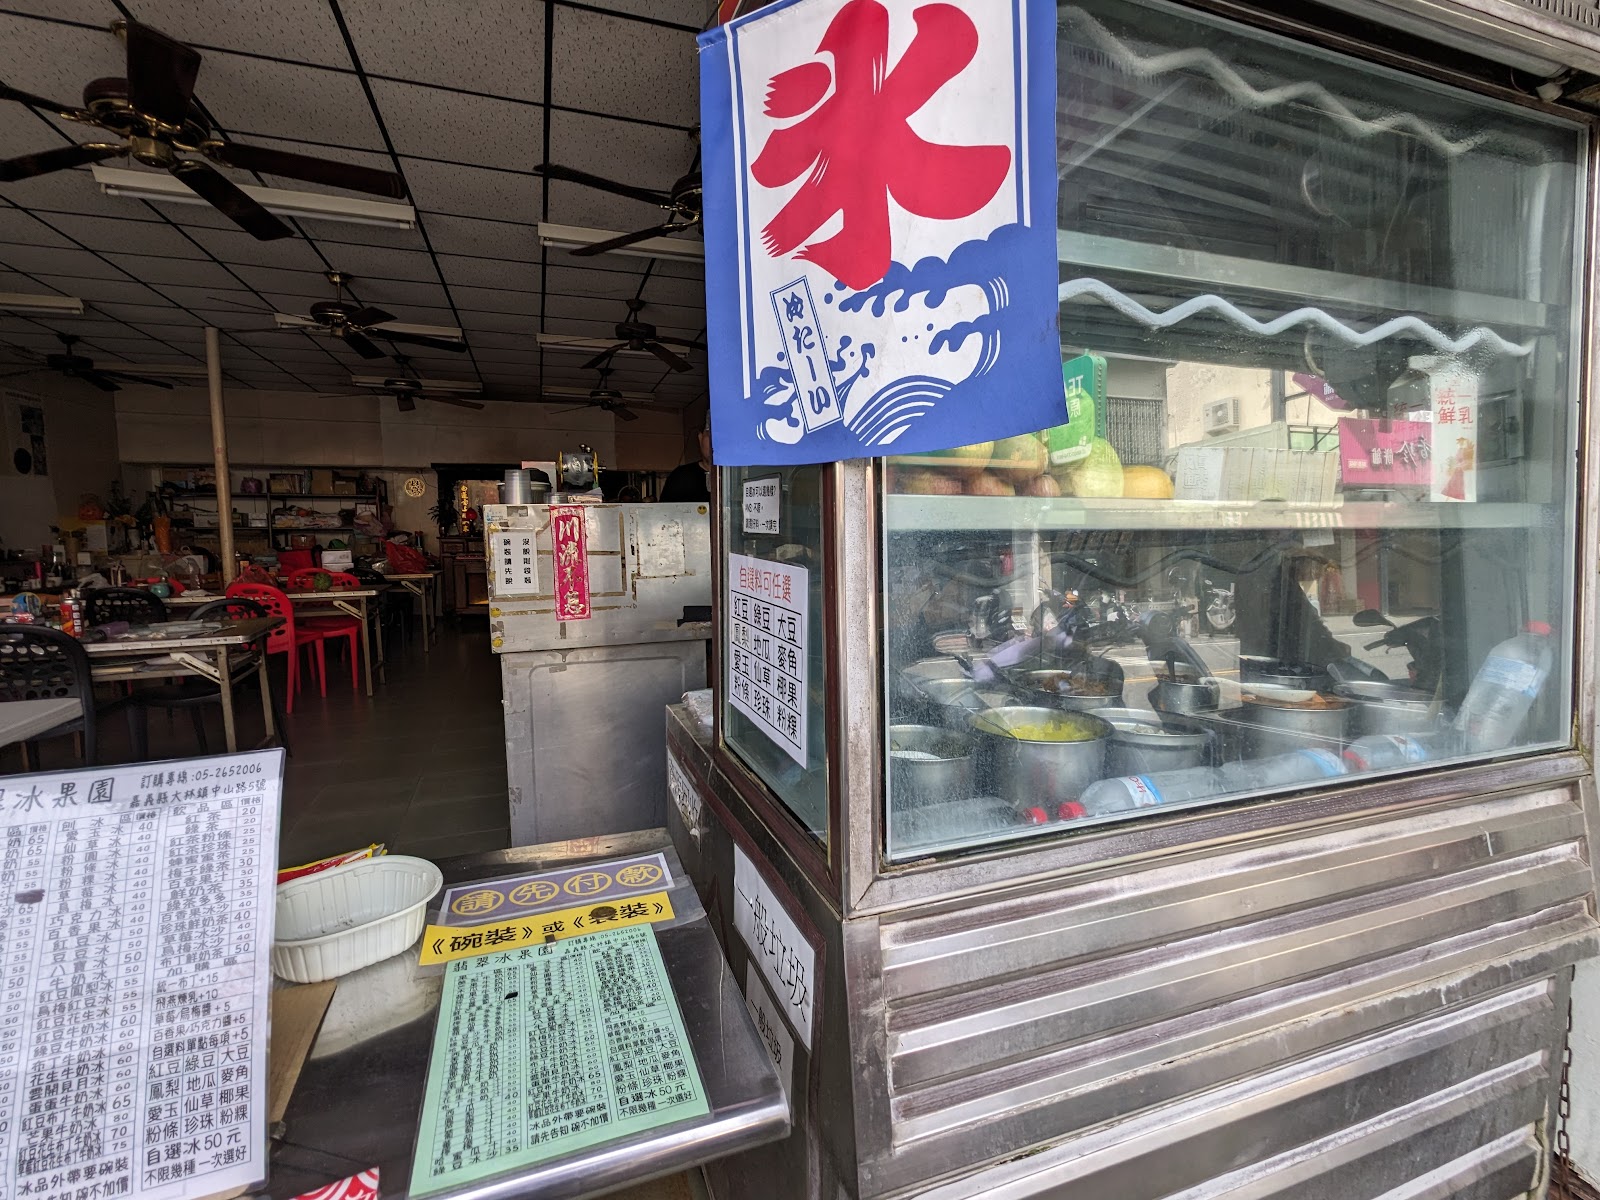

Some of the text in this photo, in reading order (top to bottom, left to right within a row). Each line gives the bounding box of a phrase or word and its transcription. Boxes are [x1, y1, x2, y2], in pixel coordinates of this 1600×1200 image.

[1437, 406, 1473, 425] 鮮乳
[740, 565, 791, 603] 自選料可任選
[734, 596, 748, 620] 紅豆
[754, 603, 770, 631] 綠豆
[734, 624, 749, 650] 鳳梨
[778, 613, 796, 643] 大豆
[754, 634, 770, 660] 地瓜
[734, 650, 750, 677] 愛玉
[778, 644, 797, 676] 麥角
[754, 660, 770, 688] 仙草
[734, 674, 749, 702] 粉條
[777, 674, 797, 708] 椰果
[754, 690, 770, 720] 珍珠
[777, 705, 797, 740] 粉粿
[241, 798, 260, 806] 價格
[136, 811, 156, 820] 價格
[185, 807, 256, 822] 紅茶 20
[185, 822, 219, 834] 綠茶
[64, 836, 121, 854] 仙草冰
[169, 840, 231, 857] 紅茶珍珠
[240, 857, 253, 866] 30
[168, 872, 229, 890] 百香果汁
[170, 878, 253, 900] 鮮奶茶 35
[457, 865, 659, 914] 請先付款
[234, 910, 250, 920] 40
[239, 900, 252, 908] 40
[50, 906, 121, 926] 巧克力冰
[237, 922, 250, 930] 40
[48, 919, 121, 940] 百香果冰
[236, 933, 250, 941] 40
[542, 921, 565, 935] 或
[53, 928, 143, 952] 紅豆冰 50
[235, 943, 250, 954] 50
[124, 952, 142, 964] 50
[738, 886, 806, 1022] 一般垃圾
[50, 970, 107, 991] 牛奶冰
[37, 1006, 110, 1030] 紅豆花生冰
[36, 1015, 137, 1044] 紅豆牛奶冰 60
[751, 999, 782, 1070] 一般垃圾
[32, 1047, 106, 1072] 布丁牛奶冰
[184, 1051, 215, 1072] 綠豆
[221, 1043, 250, 1065] 大豆
[30, 1060, 104, 1087] 花生牛奶冰
[149, 1058, 181, 1080] 紅豆
[221, 1064, 248, 1084] 麥角
[150, 1078, 180, 1101] 鳳梨
[186, 1071, 216, 1092] 地瓜
[675, 1082, 686, 1092] 元
[184, 1092, 214, 1114] 仙草
[219, 1084, 250, 1106] 椰果
[620, 1091, 692, 1118] 不限幾種 一次選好
[22, 1094, 131, 1132] 紅豆布丁牛奶冰 65
[114, 1113, 128, 1122] 80
[148, 1100, 179, 1124] 愛玉
[220, 1103, 248, 1126] 粉粿
[529, 1102, 607, 1131] 冰品外帶要碗裝
[111, 1126, 127, 1138] 70
[146, 1121, 178, 1145] 粉條
[184, 1112, 214, 1135] 珍珠
[227, 1127, 241, 1145] 元
[531, 1125, 569, 1145] 請先告知
[112, 1142, 127, 1151] 75
[17, 1155, 129, 1196] 冰品外帶要碗裝
[144, 1145, 247, 1186] 不限幾種 一次選好
